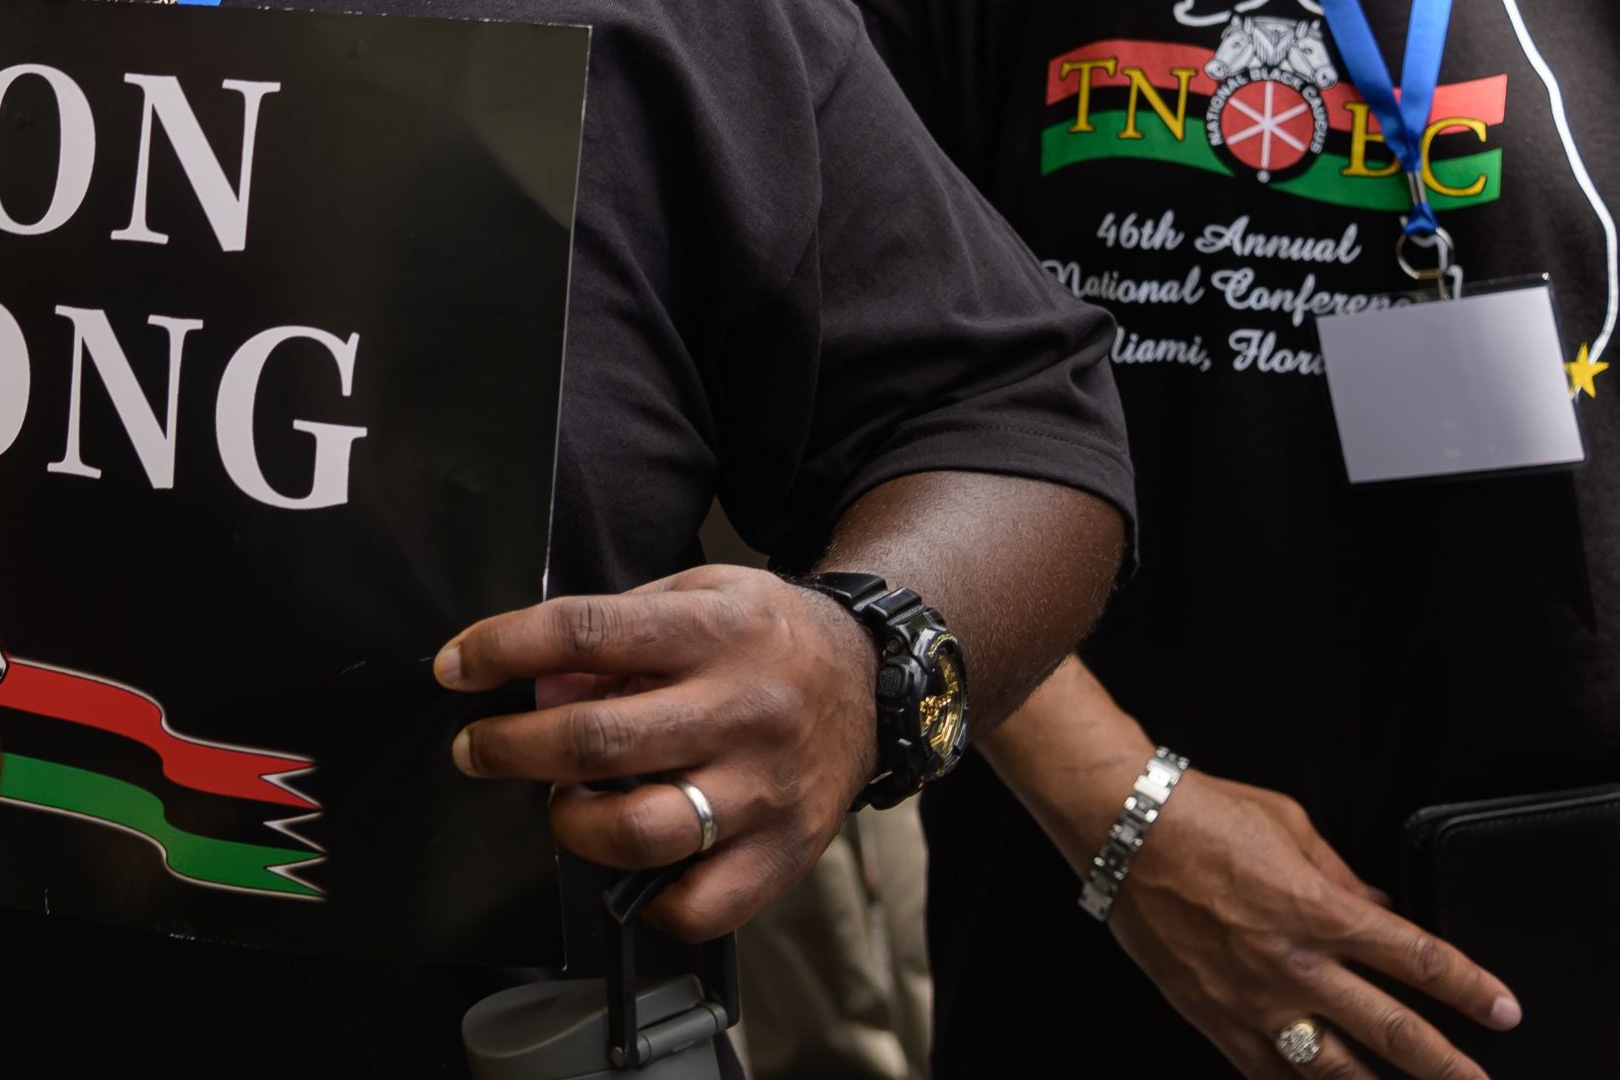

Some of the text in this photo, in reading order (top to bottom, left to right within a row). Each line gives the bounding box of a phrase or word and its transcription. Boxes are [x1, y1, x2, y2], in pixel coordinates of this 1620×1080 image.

[1059, 56, 1198, 142] TN
[1206, 68, 1328, 154] NATIONAL BLACK CAUCUS
[1096, 209, 1362, 265] 46th Annual
[1040, 259, 1206, 305] National
